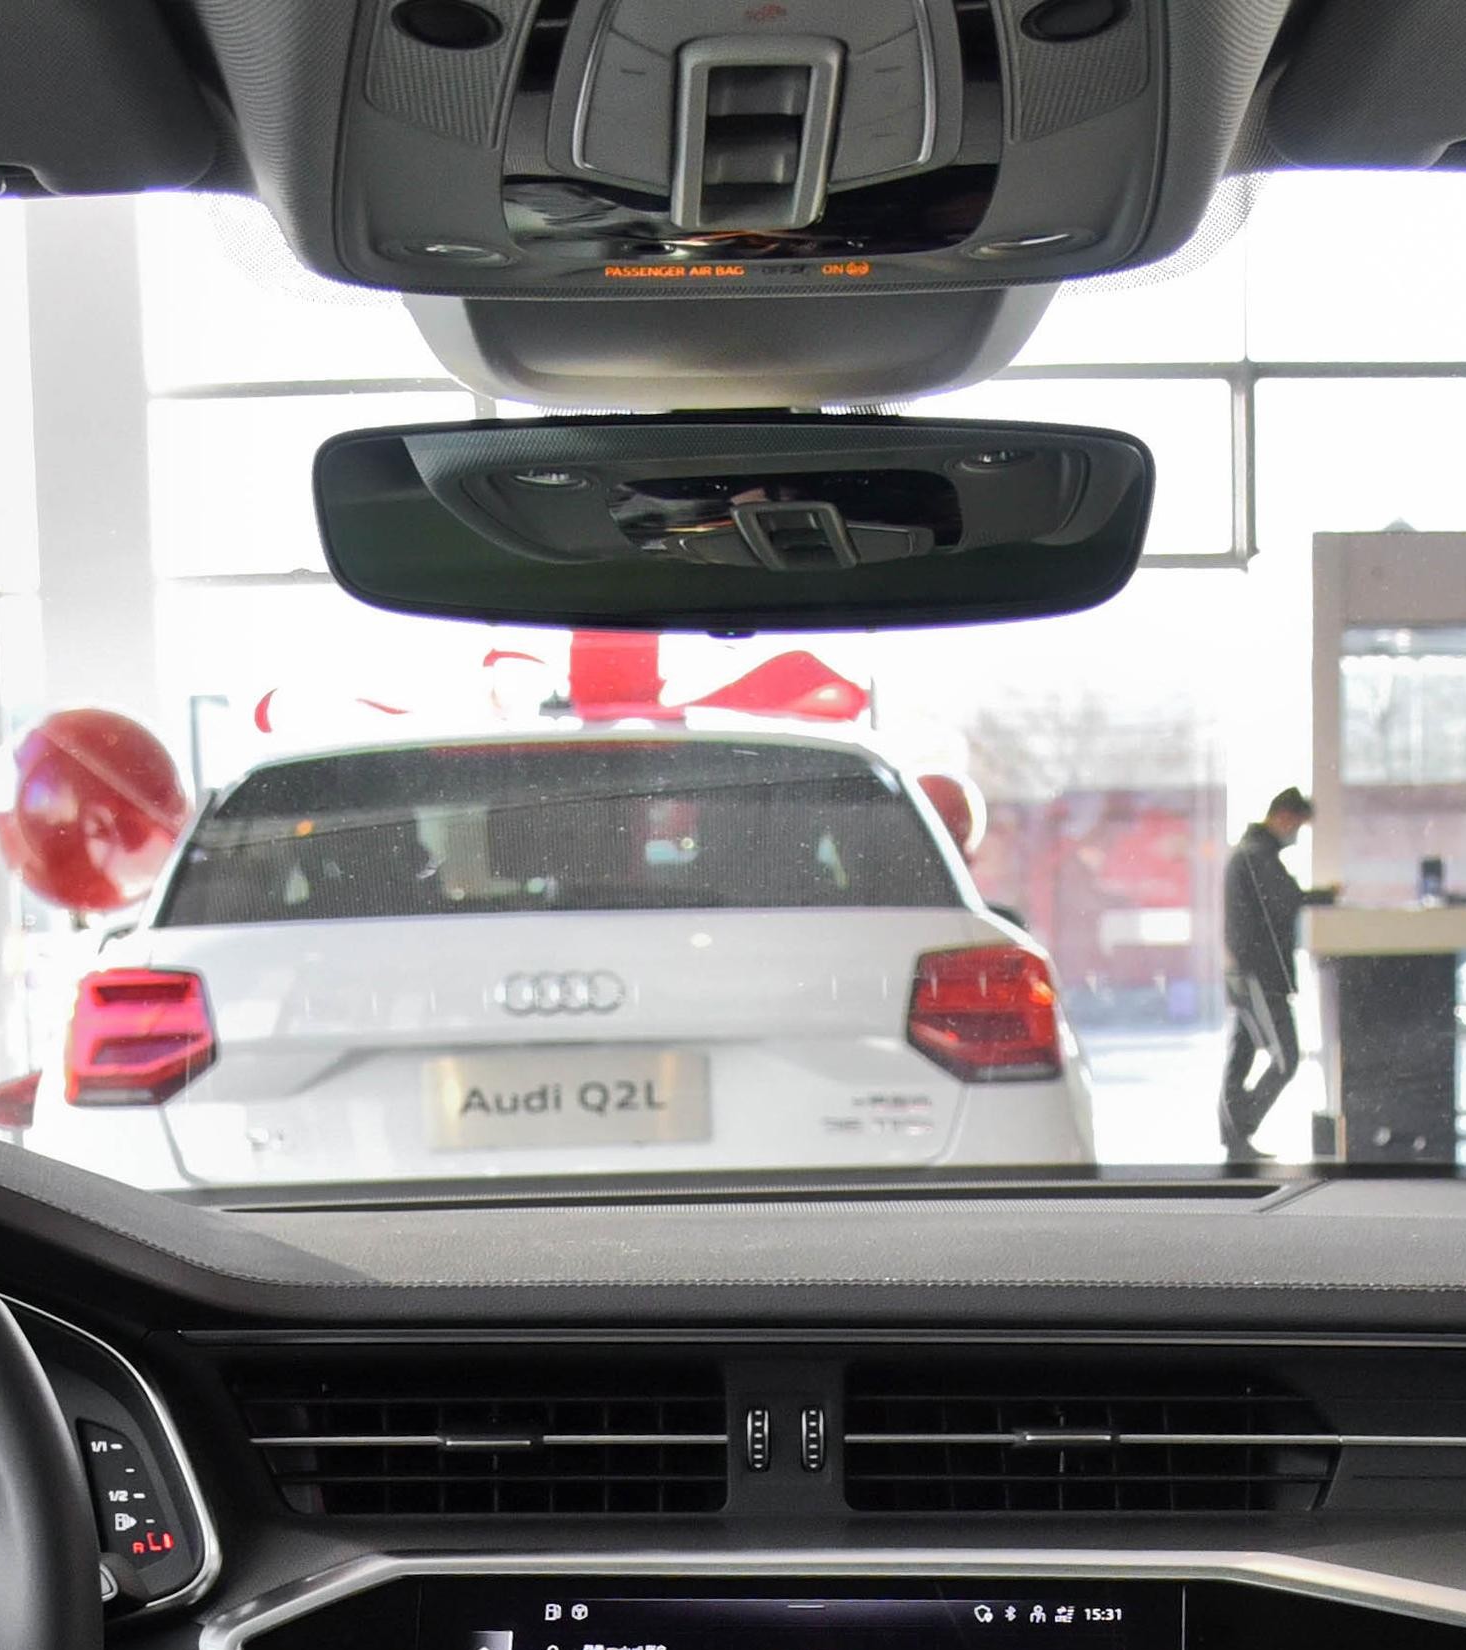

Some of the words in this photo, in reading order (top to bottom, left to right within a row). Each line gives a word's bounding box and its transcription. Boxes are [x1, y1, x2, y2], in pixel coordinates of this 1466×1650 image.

[604, 265, 684, 278] PASSENGER
[689, 265, 712, 277] AIR
[715, 264, 745, 277] BAG
[821, 264, 844, 276] ON
[459, 1081, 563, 1117] Audi
[577, 1079, 667, 1117] Q2L
[91, 1441, 108, 1453] 1/1
[108, 1490, 129, 1502] 1/2
[1084, 1607, 1123, 1622] 15:31
